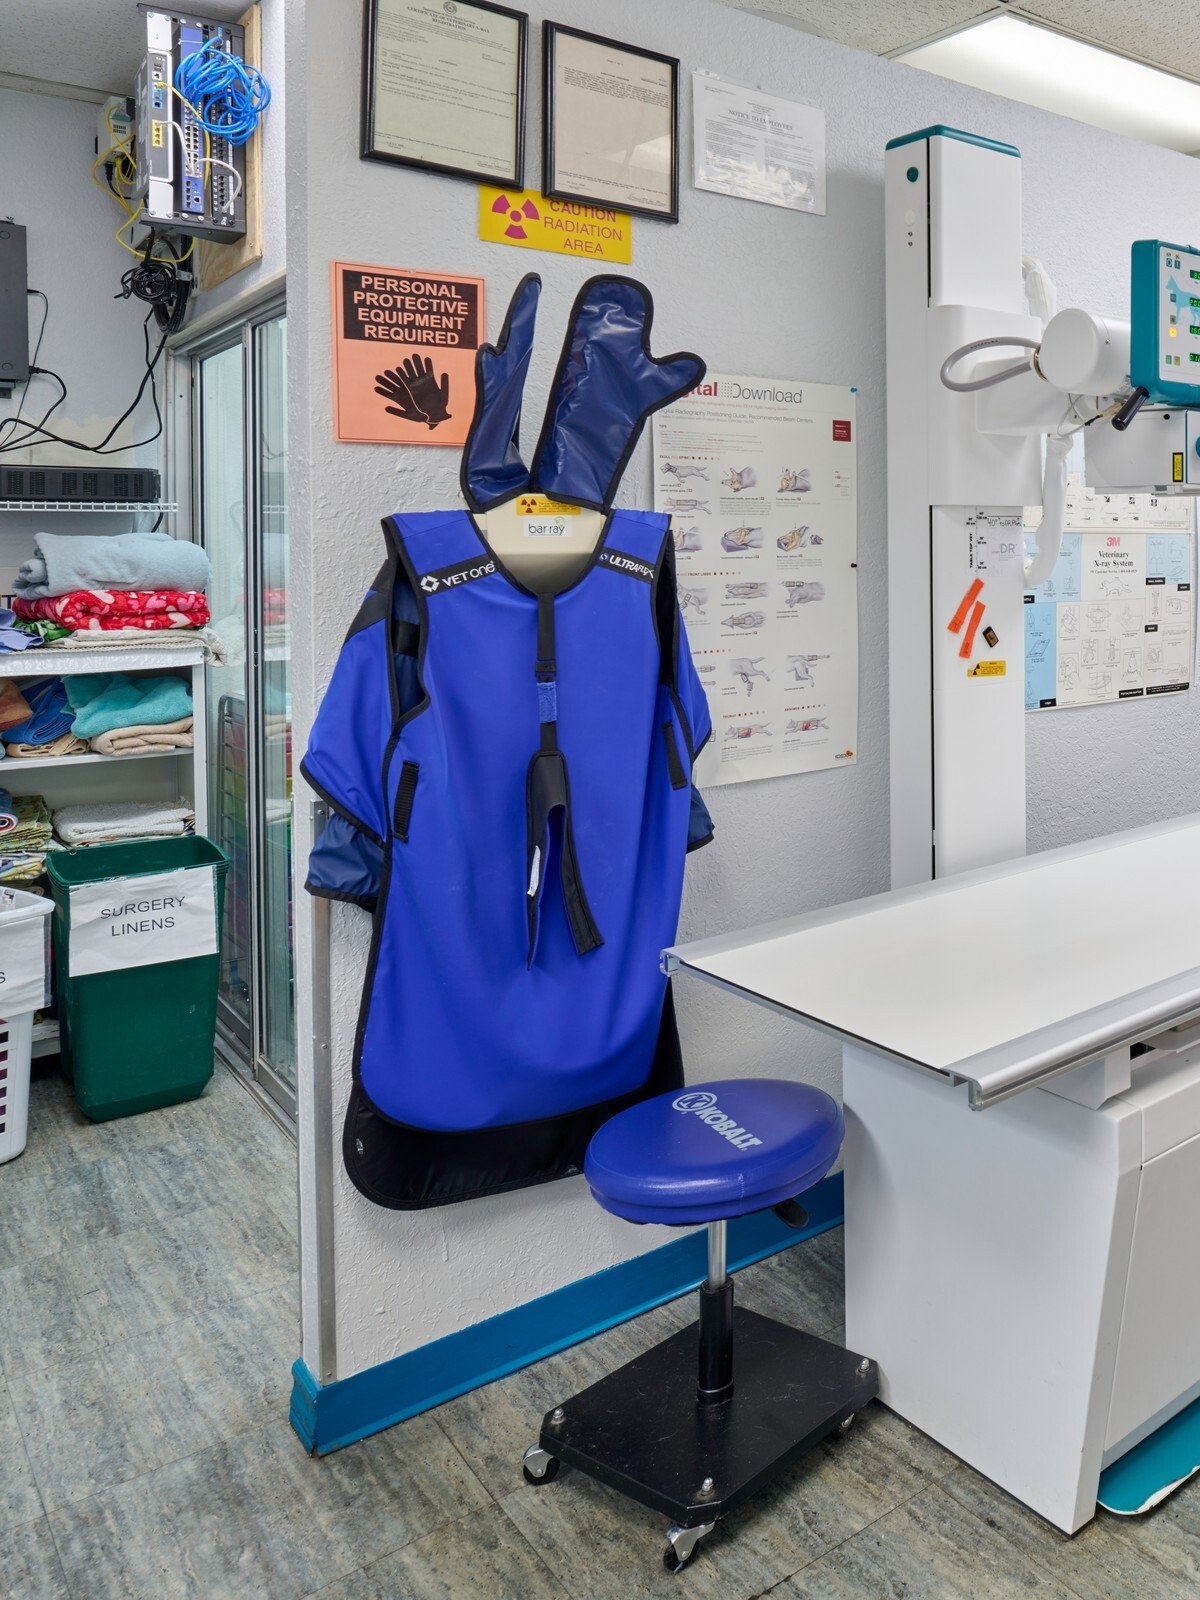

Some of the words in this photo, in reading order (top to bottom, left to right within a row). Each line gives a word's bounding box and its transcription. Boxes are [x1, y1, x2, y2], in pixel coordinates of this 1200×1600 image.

[728, 109, 750, 120] NOTICE
[550, 201, 617, 223] CAUTION
[544, 216, 622, 241] RADIATION
[563, 238, 604, 255] AREA
[361, 276, 462, 299] PERSONAL
[353, 290, 469, 315] PROTECTIVE
[358, 308, 465, 330] EQUIPMENT
[364, 324, 460, 345] REQUIRED
[728, 382, 803, 404] Download
[1106, 536, 1120, 547] 3M
[1094, 560, 1110, 569] X-ray
[1112, 560, 1134, 569] System
[1098, 550, 1128, 560] Veterinary
[442, 572, 468, 588] VET
[100, 896, 186, 920] SURGERY
[111, 917, 175, 937] LINENS
[694, 1106, 763, 1150] KOBALT
